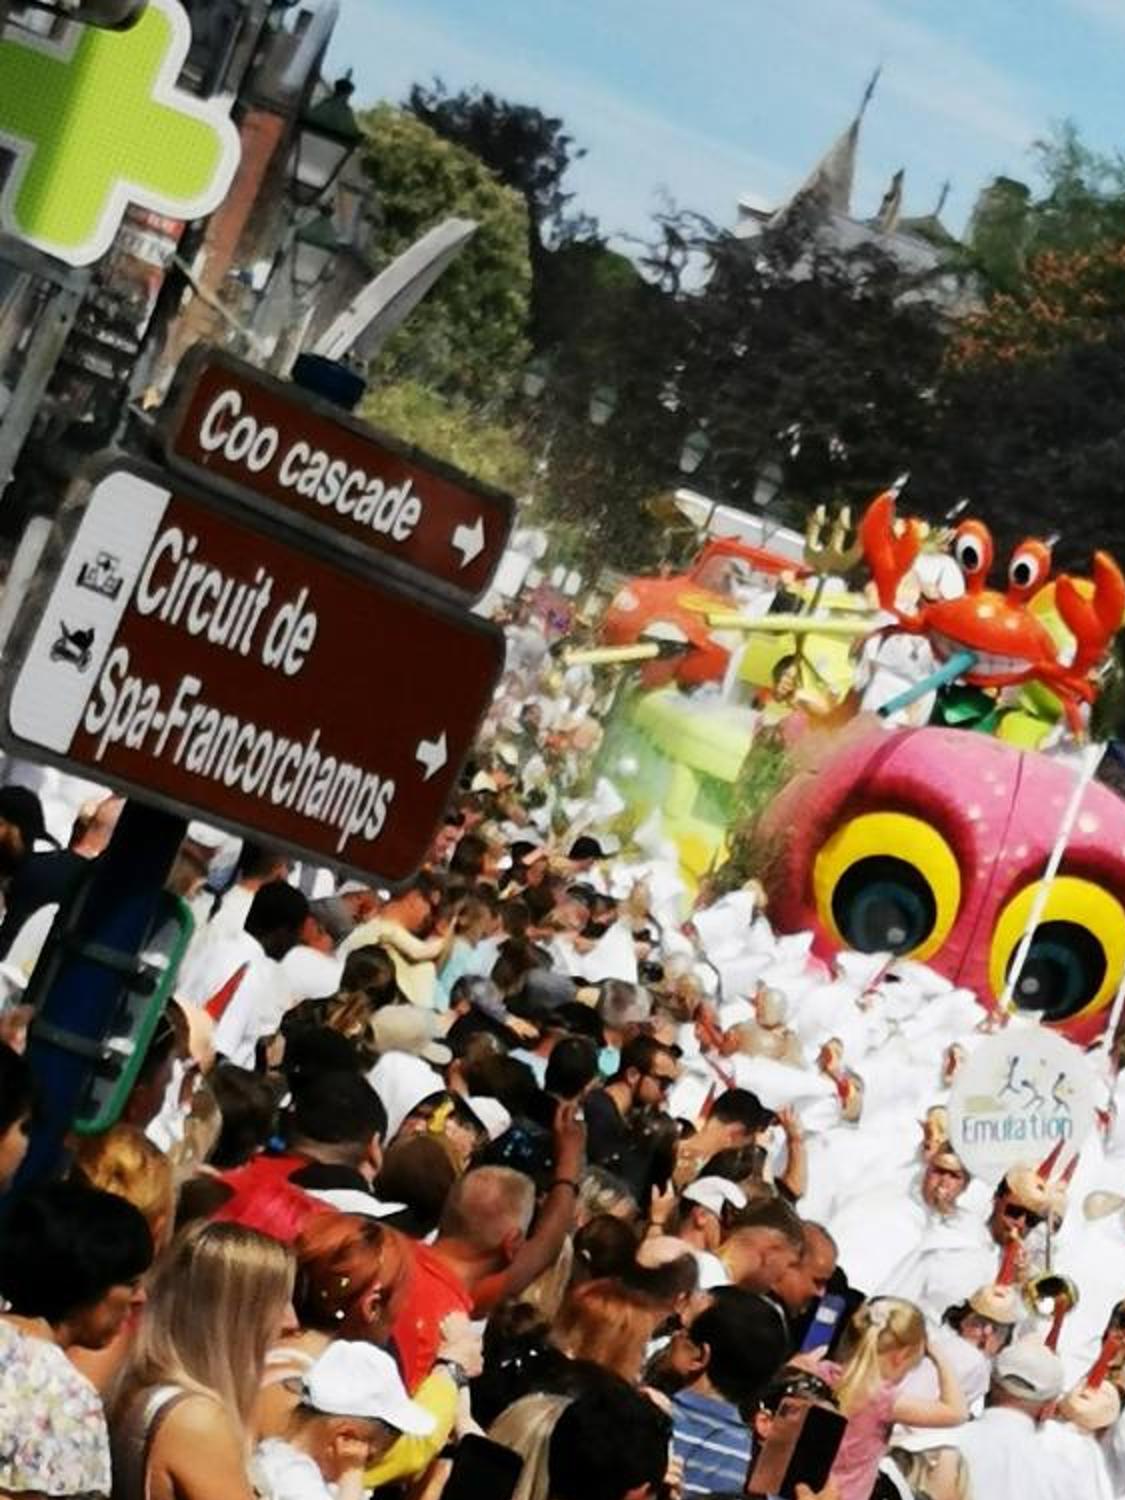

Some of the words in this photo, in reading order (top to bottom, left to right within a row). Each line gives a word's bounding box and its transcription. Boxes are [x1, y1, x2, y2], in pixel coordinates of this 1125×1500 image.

[199, 389, 279, 472] Coo
[278, 441, 422, 542] cascade
[136, 527, 273, 656] Circuit
[261, 586, 318, 675] de
[84, 646, 395, 854] Spa-Francorchamps
[961, 1114, 1072, 1144] Emulation
